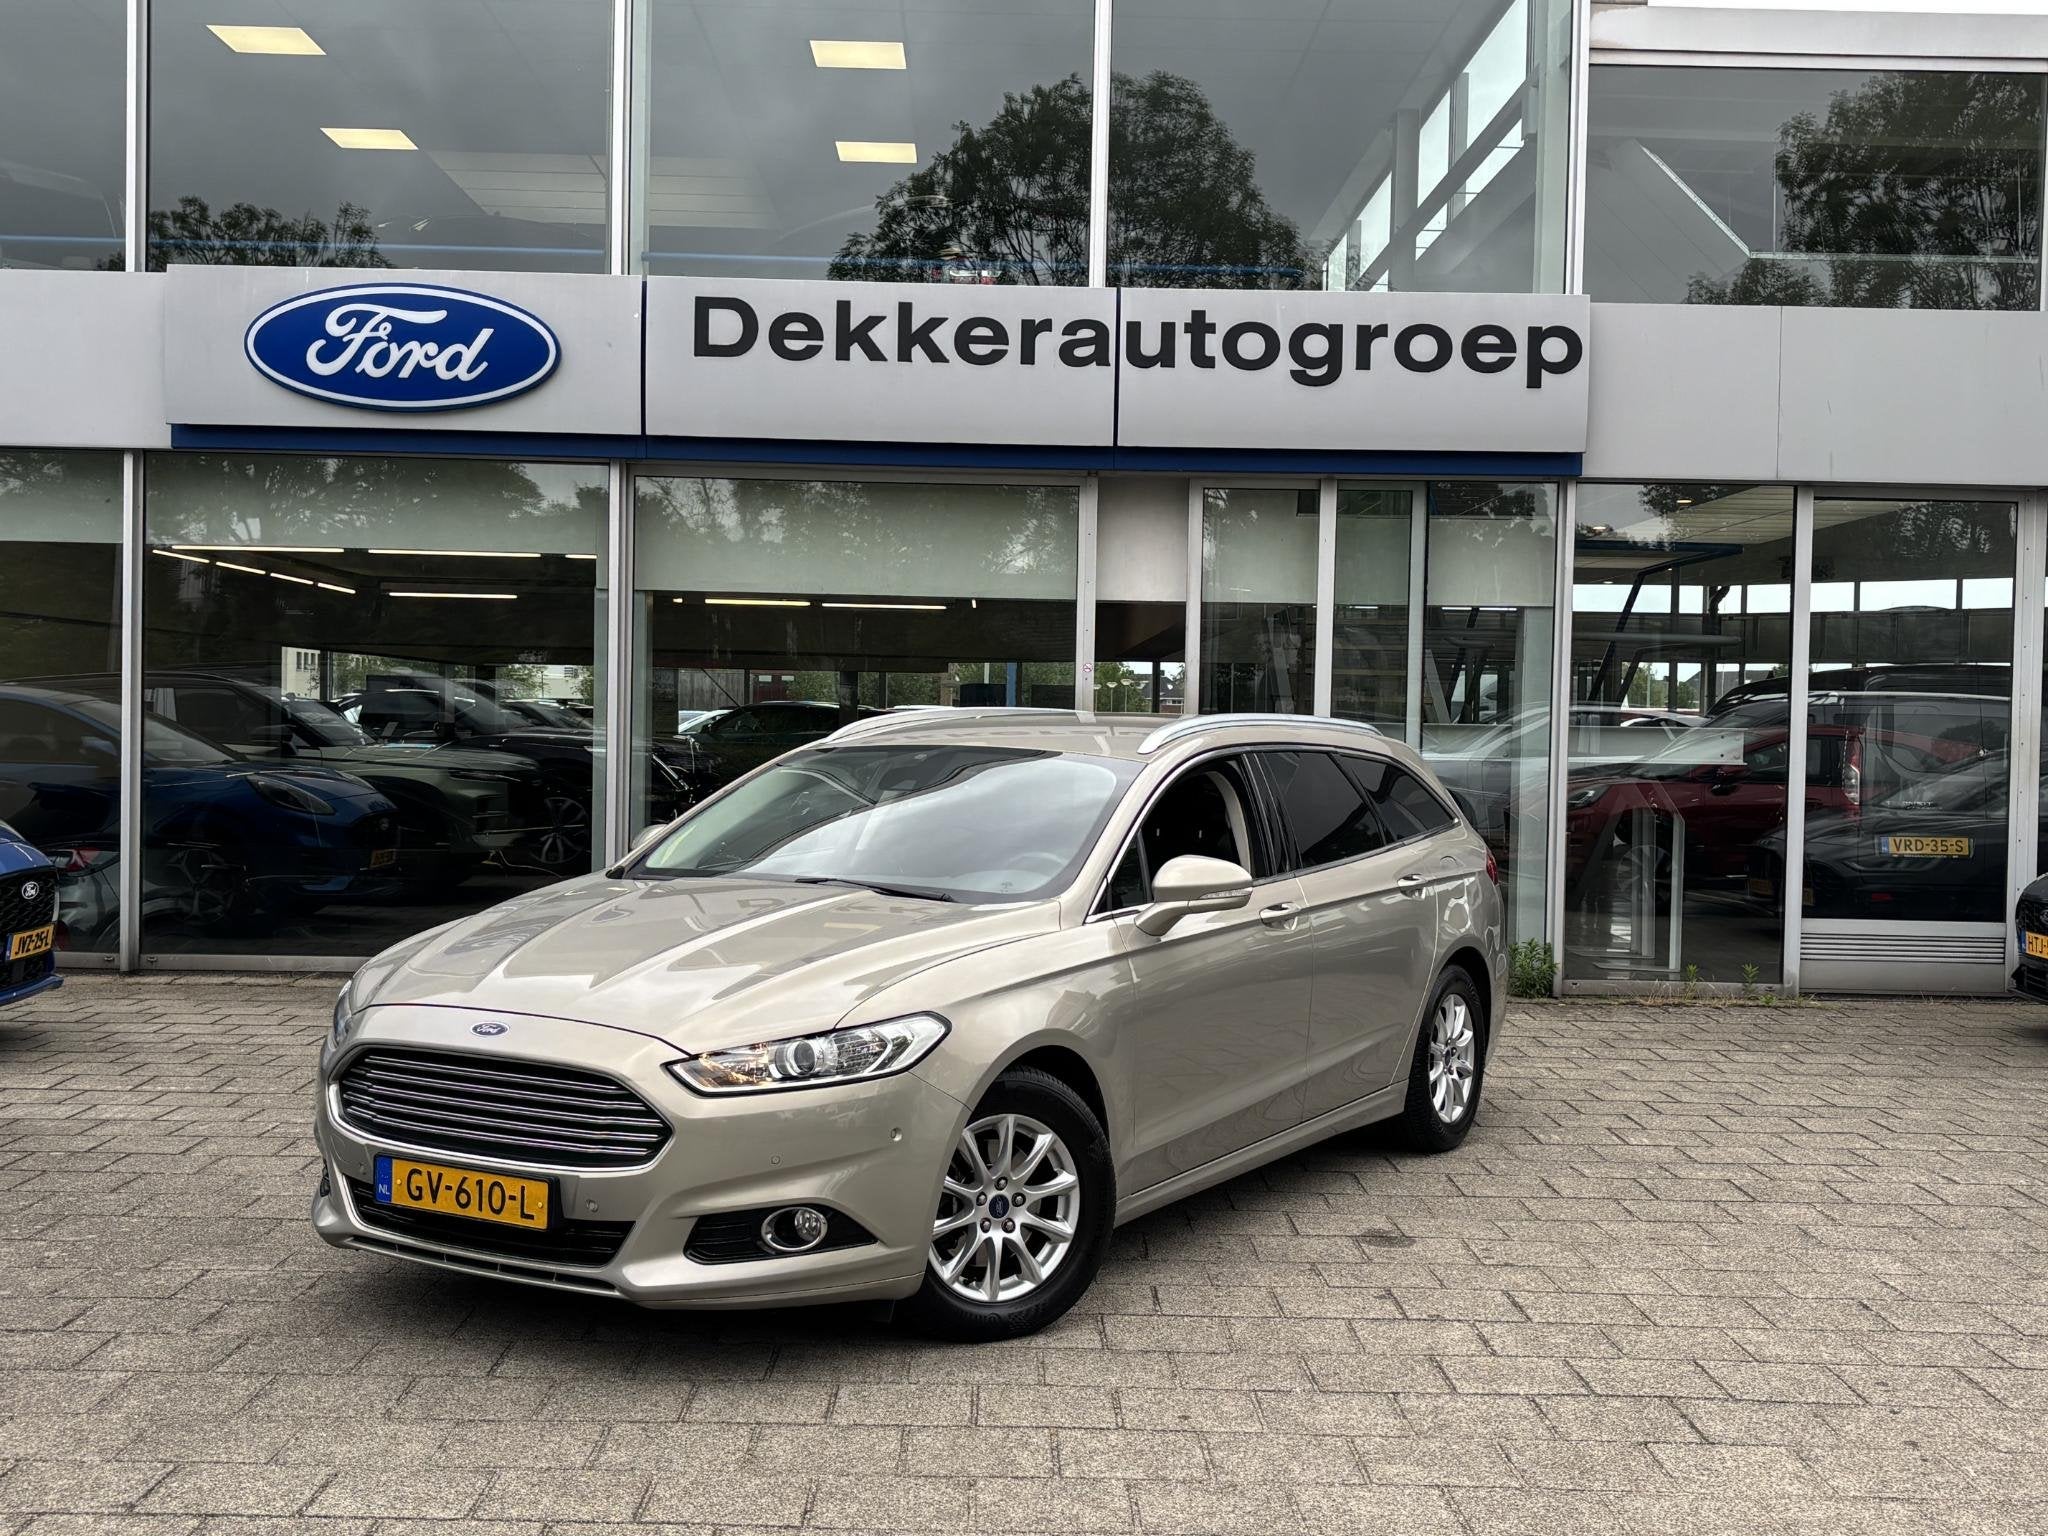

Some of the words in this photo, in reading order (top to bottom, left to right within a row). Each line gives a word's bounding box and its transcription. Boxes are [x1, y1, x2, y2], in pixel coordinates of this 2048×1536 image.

[306, 303, 494, 381] Ford
[693, 296, 1583, 389] Dekkerautogroep
[1893, 838, 1964, 853] VRD-35-S
[14, 929, 50, 955] JVZ-25-L
[2027, 934, 2048, 956] HTJ-
[378, 1183, 390, 1196] NL
[406, 1168, 535, 1221] GV-610-L
